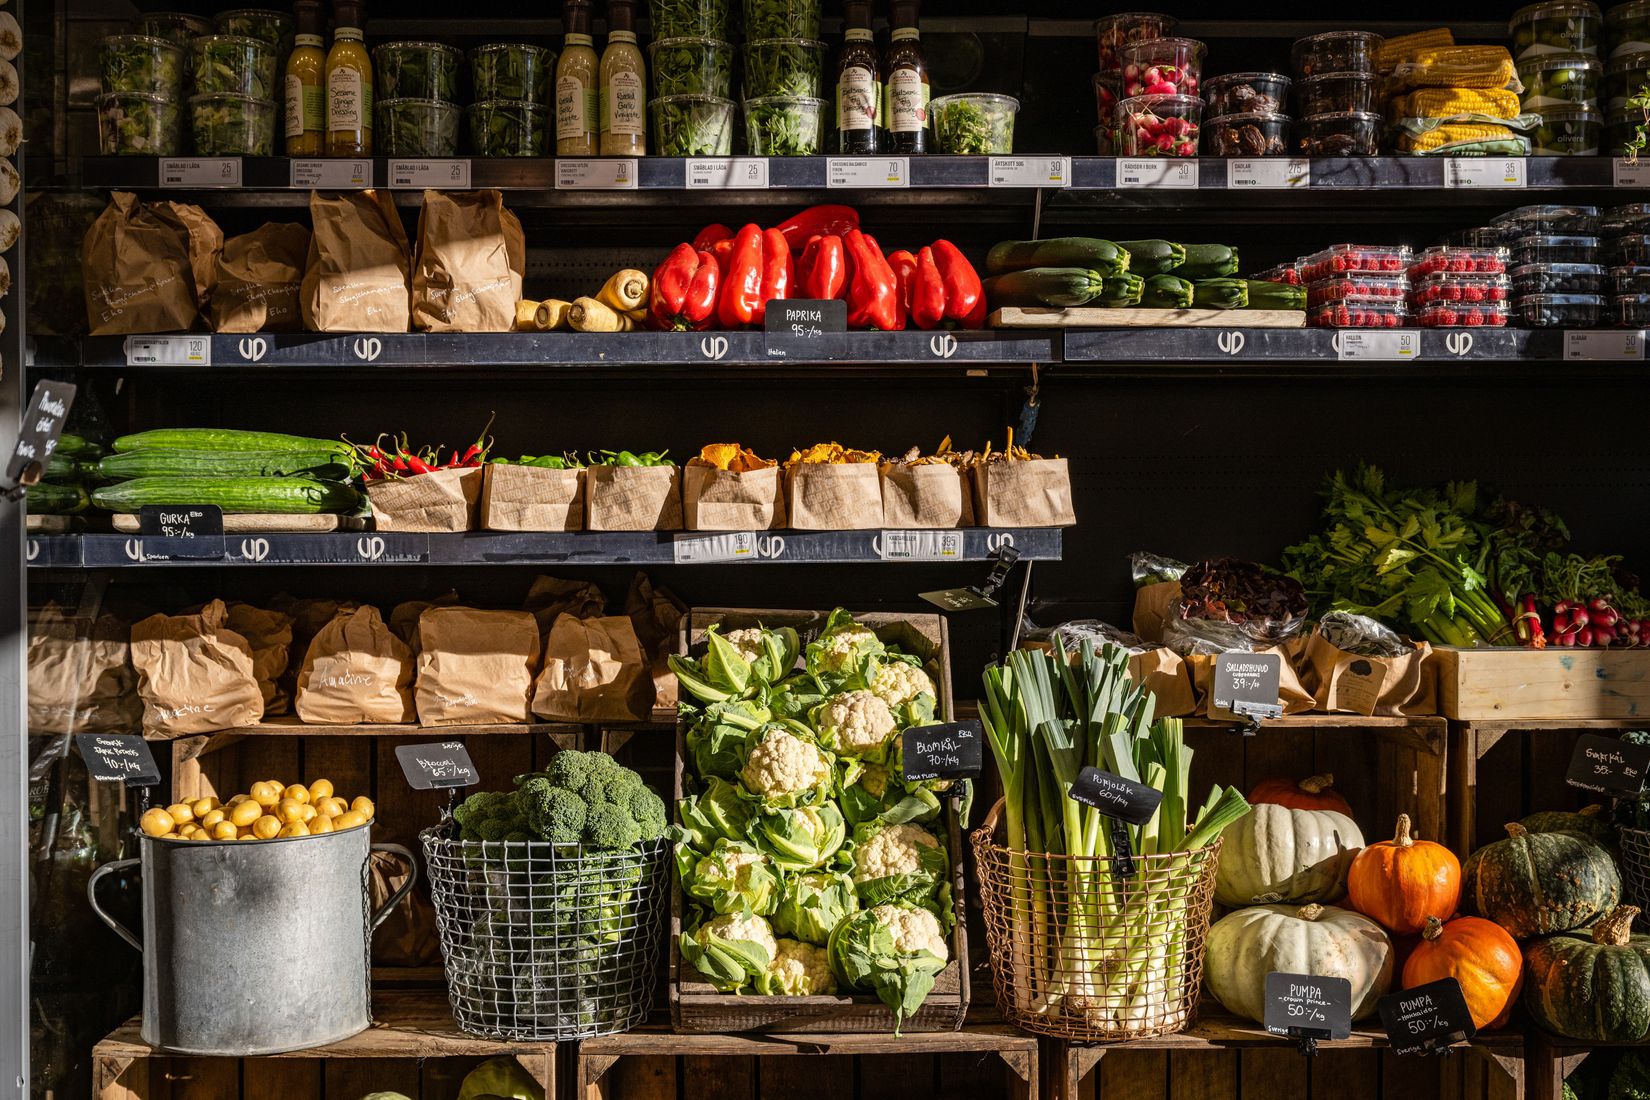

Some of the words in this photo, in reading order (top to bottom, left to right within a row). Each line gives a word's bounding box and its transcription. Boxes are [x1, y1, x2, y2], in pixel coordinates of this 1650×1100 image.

[222, 163, 231, 173] 25
[353, 163, 362, 174] 70
[451, 165, 461, 175] 25
[617, 164, 626, 174] 70
[748, 165, 758, 175] 25
[889, 162, 898, 172] 70
[1051, 161, 1061, 172] 30
[1178, 162, 1189, 173] 30
[1289, 163, 1302, 174] 275
[1505, 163, 1514, 173] 35
[101, 308, 123, 322] Eko
[268, 306, 288, 317] Eko
[786, 308, 822, 323] PAPRIKA
[1400, 335, 1410, 346] 50
[1626, 336, 1635, 346] 50
[190, 341, 202, 352] 120
[160, 512, 190, 525] GURKA
[735, 533, 748, 545] 190
[942, 536, 955, 547] 395
[1225, 662, 1269, 673] SALLADSHUVUD
[958, 730, 974, 738] EKO
[916, 737, 961, 755] BLOMKÅL
[1290, 983, 1322, 999] PUMPA
[1399, 994, 1433, 1013] PUMPA
[1268, 1025, 1289, 1035] Sverige
[1396, 1045, 1422, 1056] Sverige
